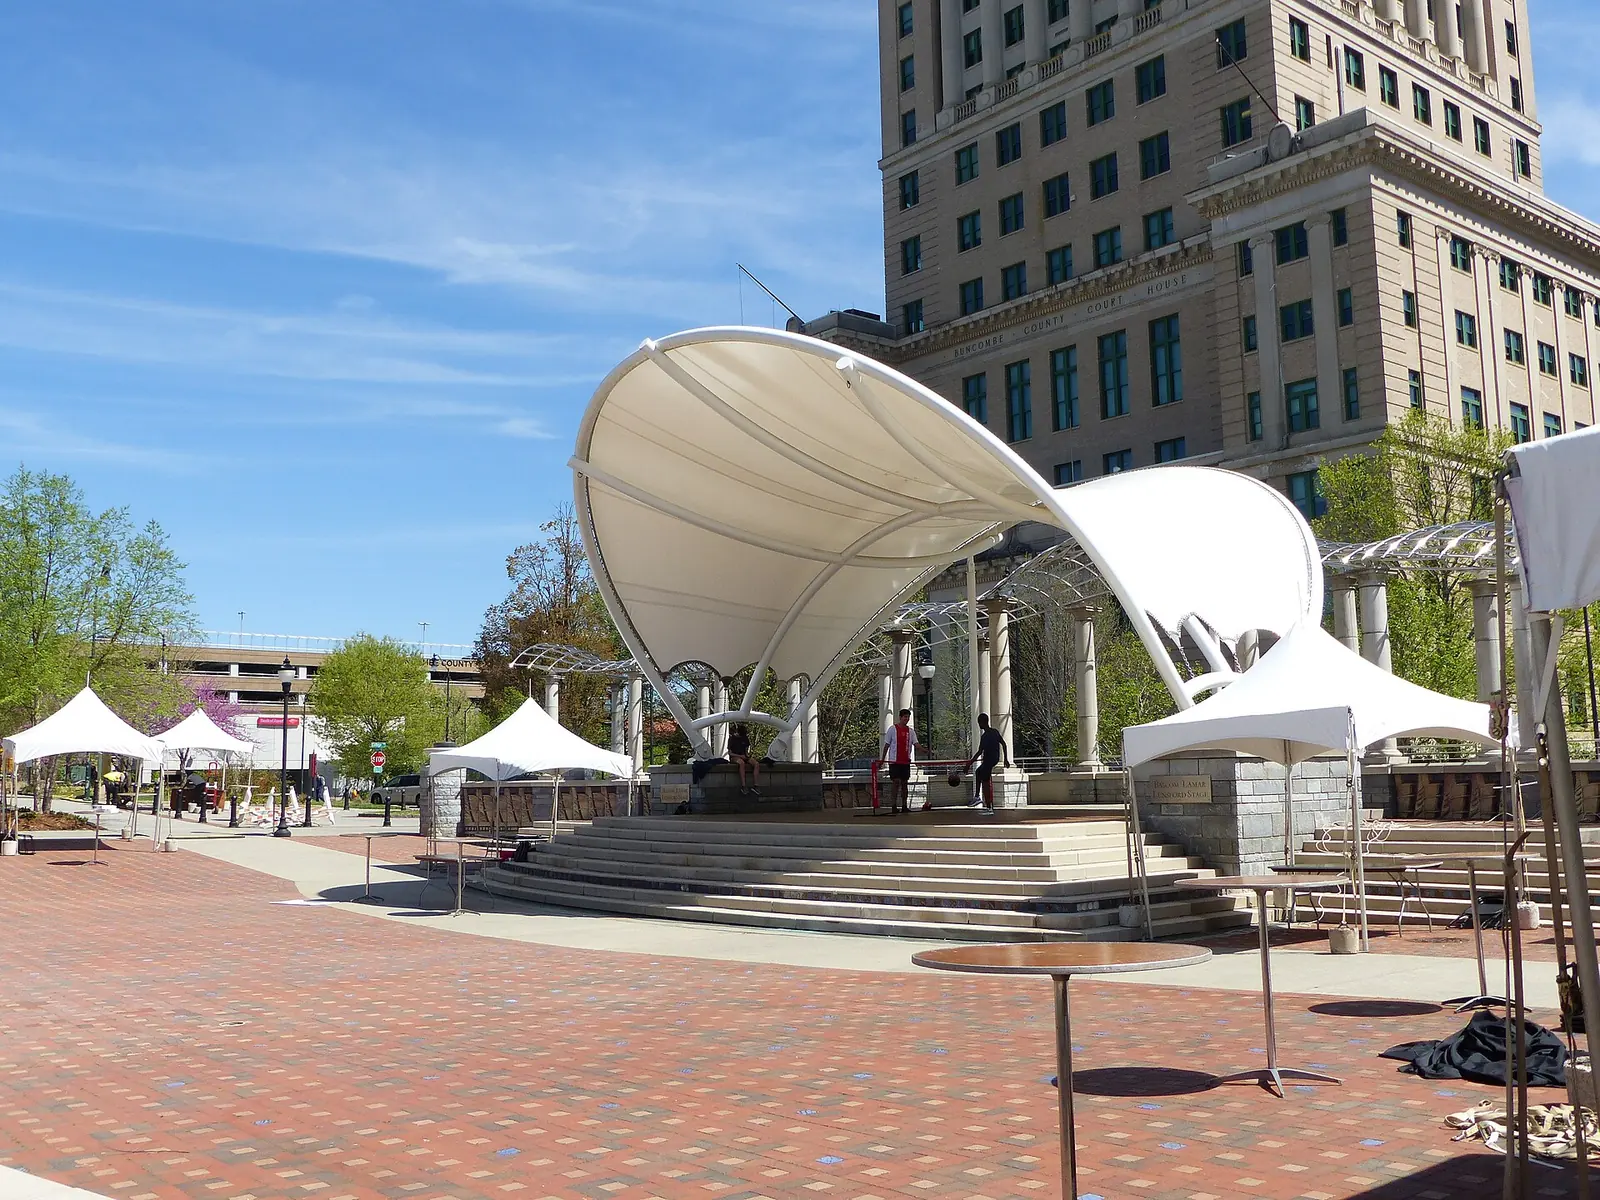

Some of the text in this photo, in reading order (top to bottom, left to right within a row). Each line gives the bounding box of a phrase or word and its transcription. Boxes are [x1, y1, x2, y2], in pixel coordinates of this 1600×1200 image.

[954, 274, 1187, 358] BUNCOMBE COUNTY COURT HOUSE
[441, 659, 474, 668] COUNTY
[372, 756, 385, 764] STOP
[1181, 779, 1207, 788] LAMAR
